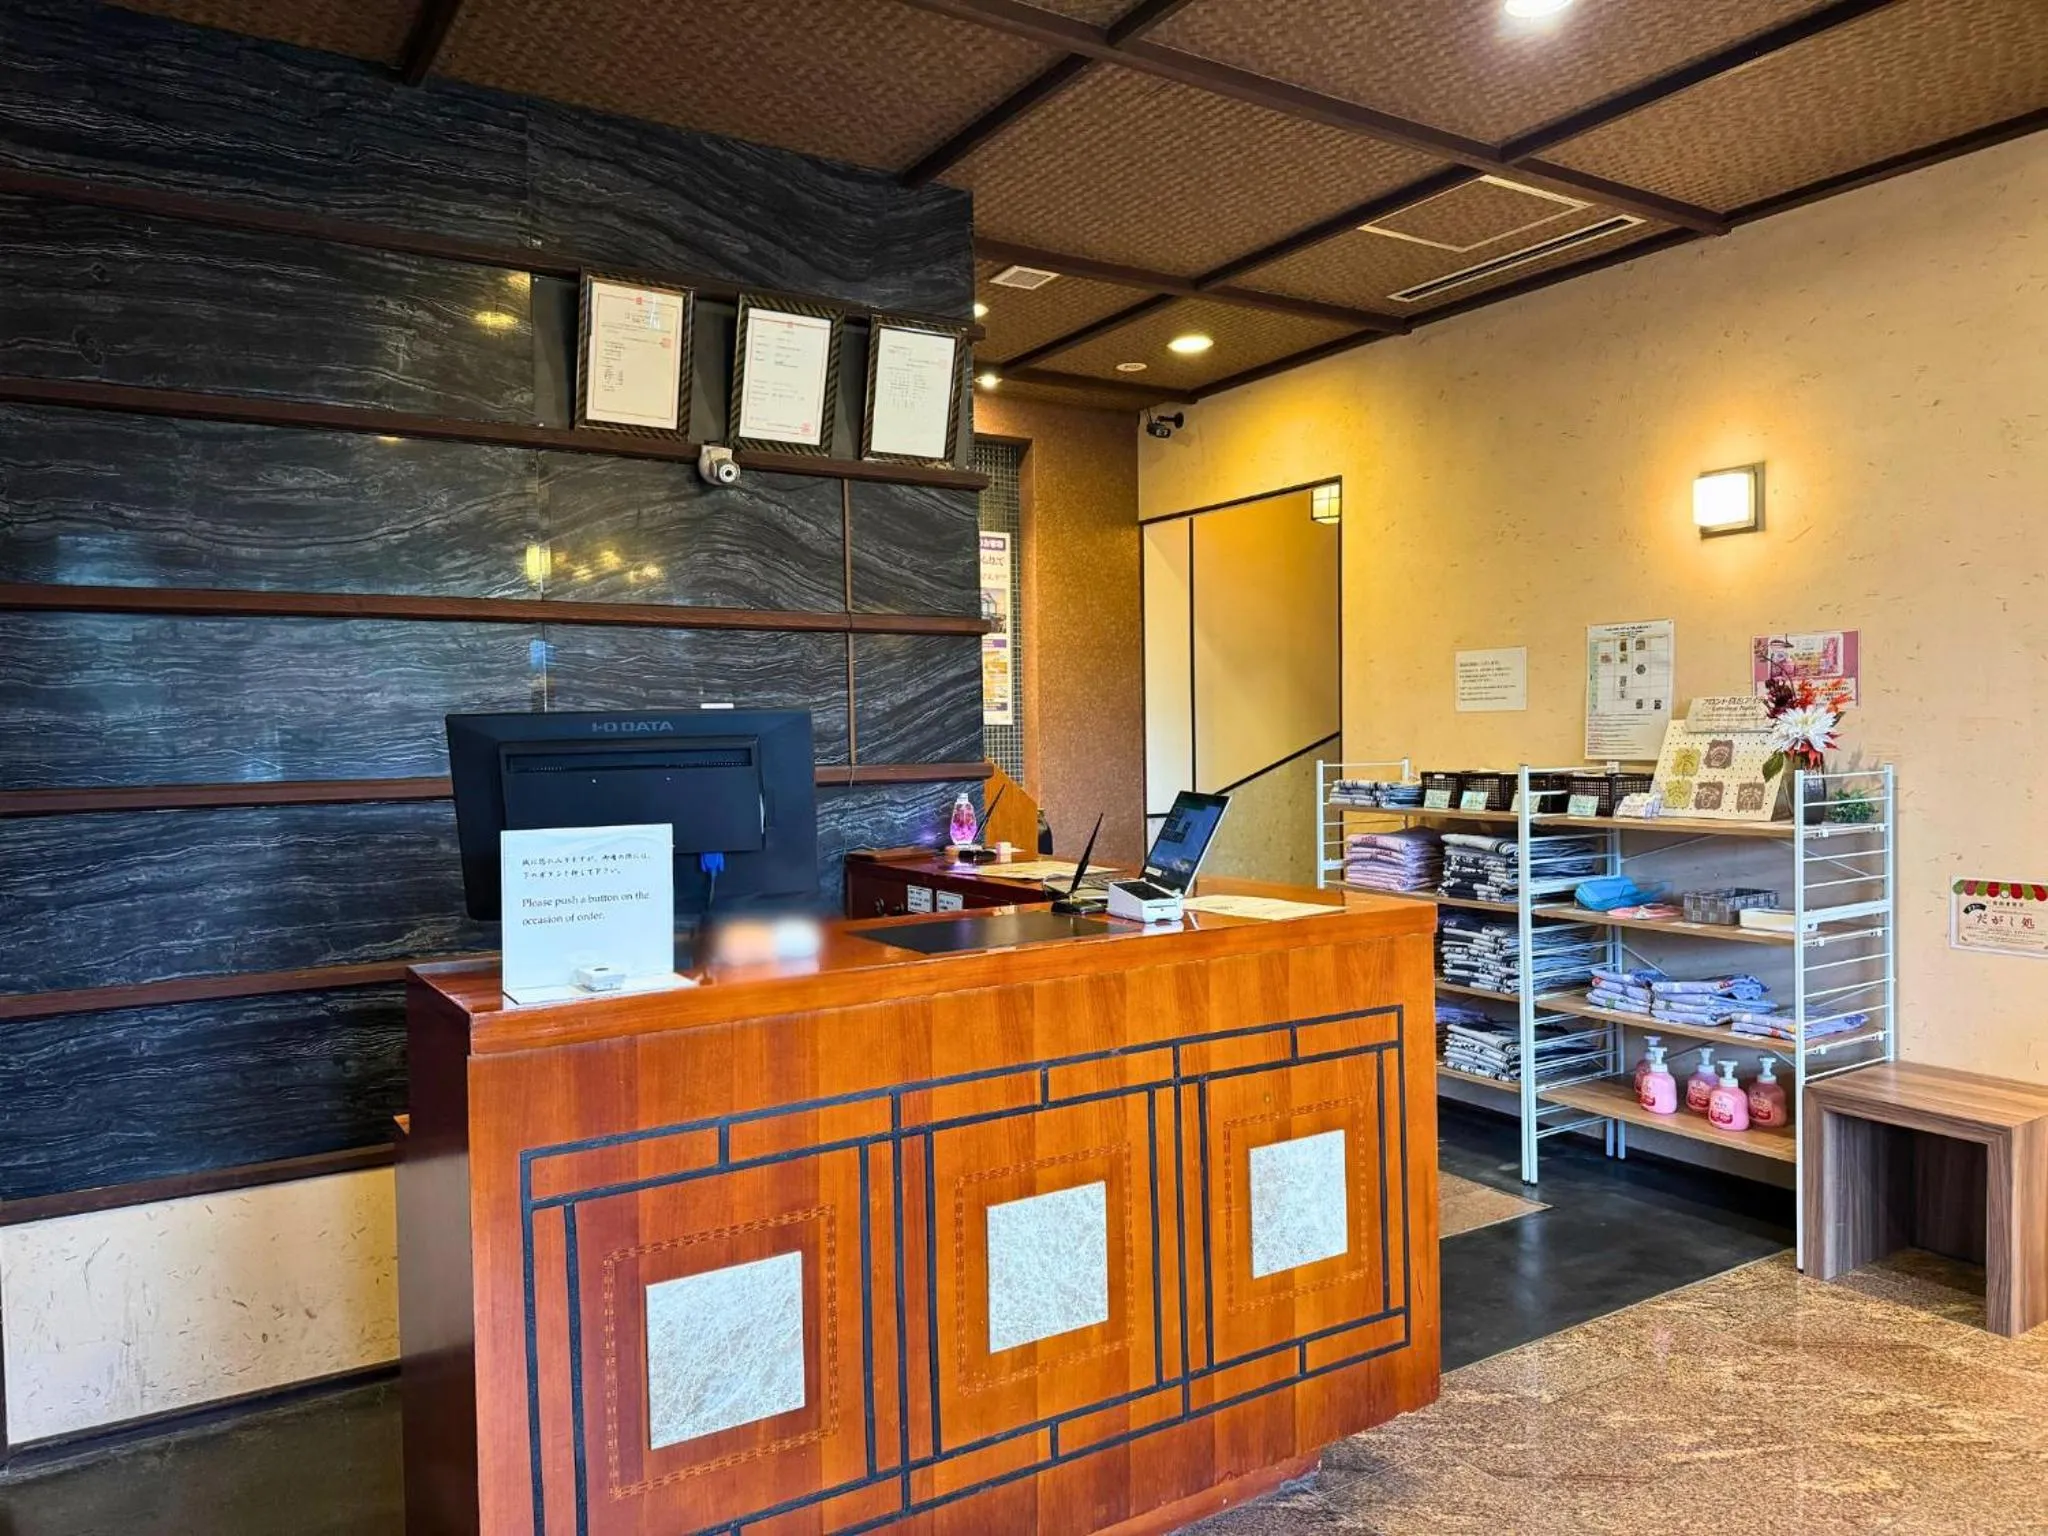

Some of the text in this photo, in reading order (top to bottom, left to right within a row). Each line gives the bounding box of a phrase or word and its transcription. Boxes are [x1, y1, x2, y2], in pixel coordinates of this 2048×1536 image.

[621, 721, 674, 732] DATA
[522, 897, 553, 908] Please
[555, 895, 578, 909] push
[588, 892, 619, 904] button
[620, 894, 633, 902] on
[635, 890, 649, 900] the
[522, 914, 564, 927] occasion
[565, 912, 575, 923] of
